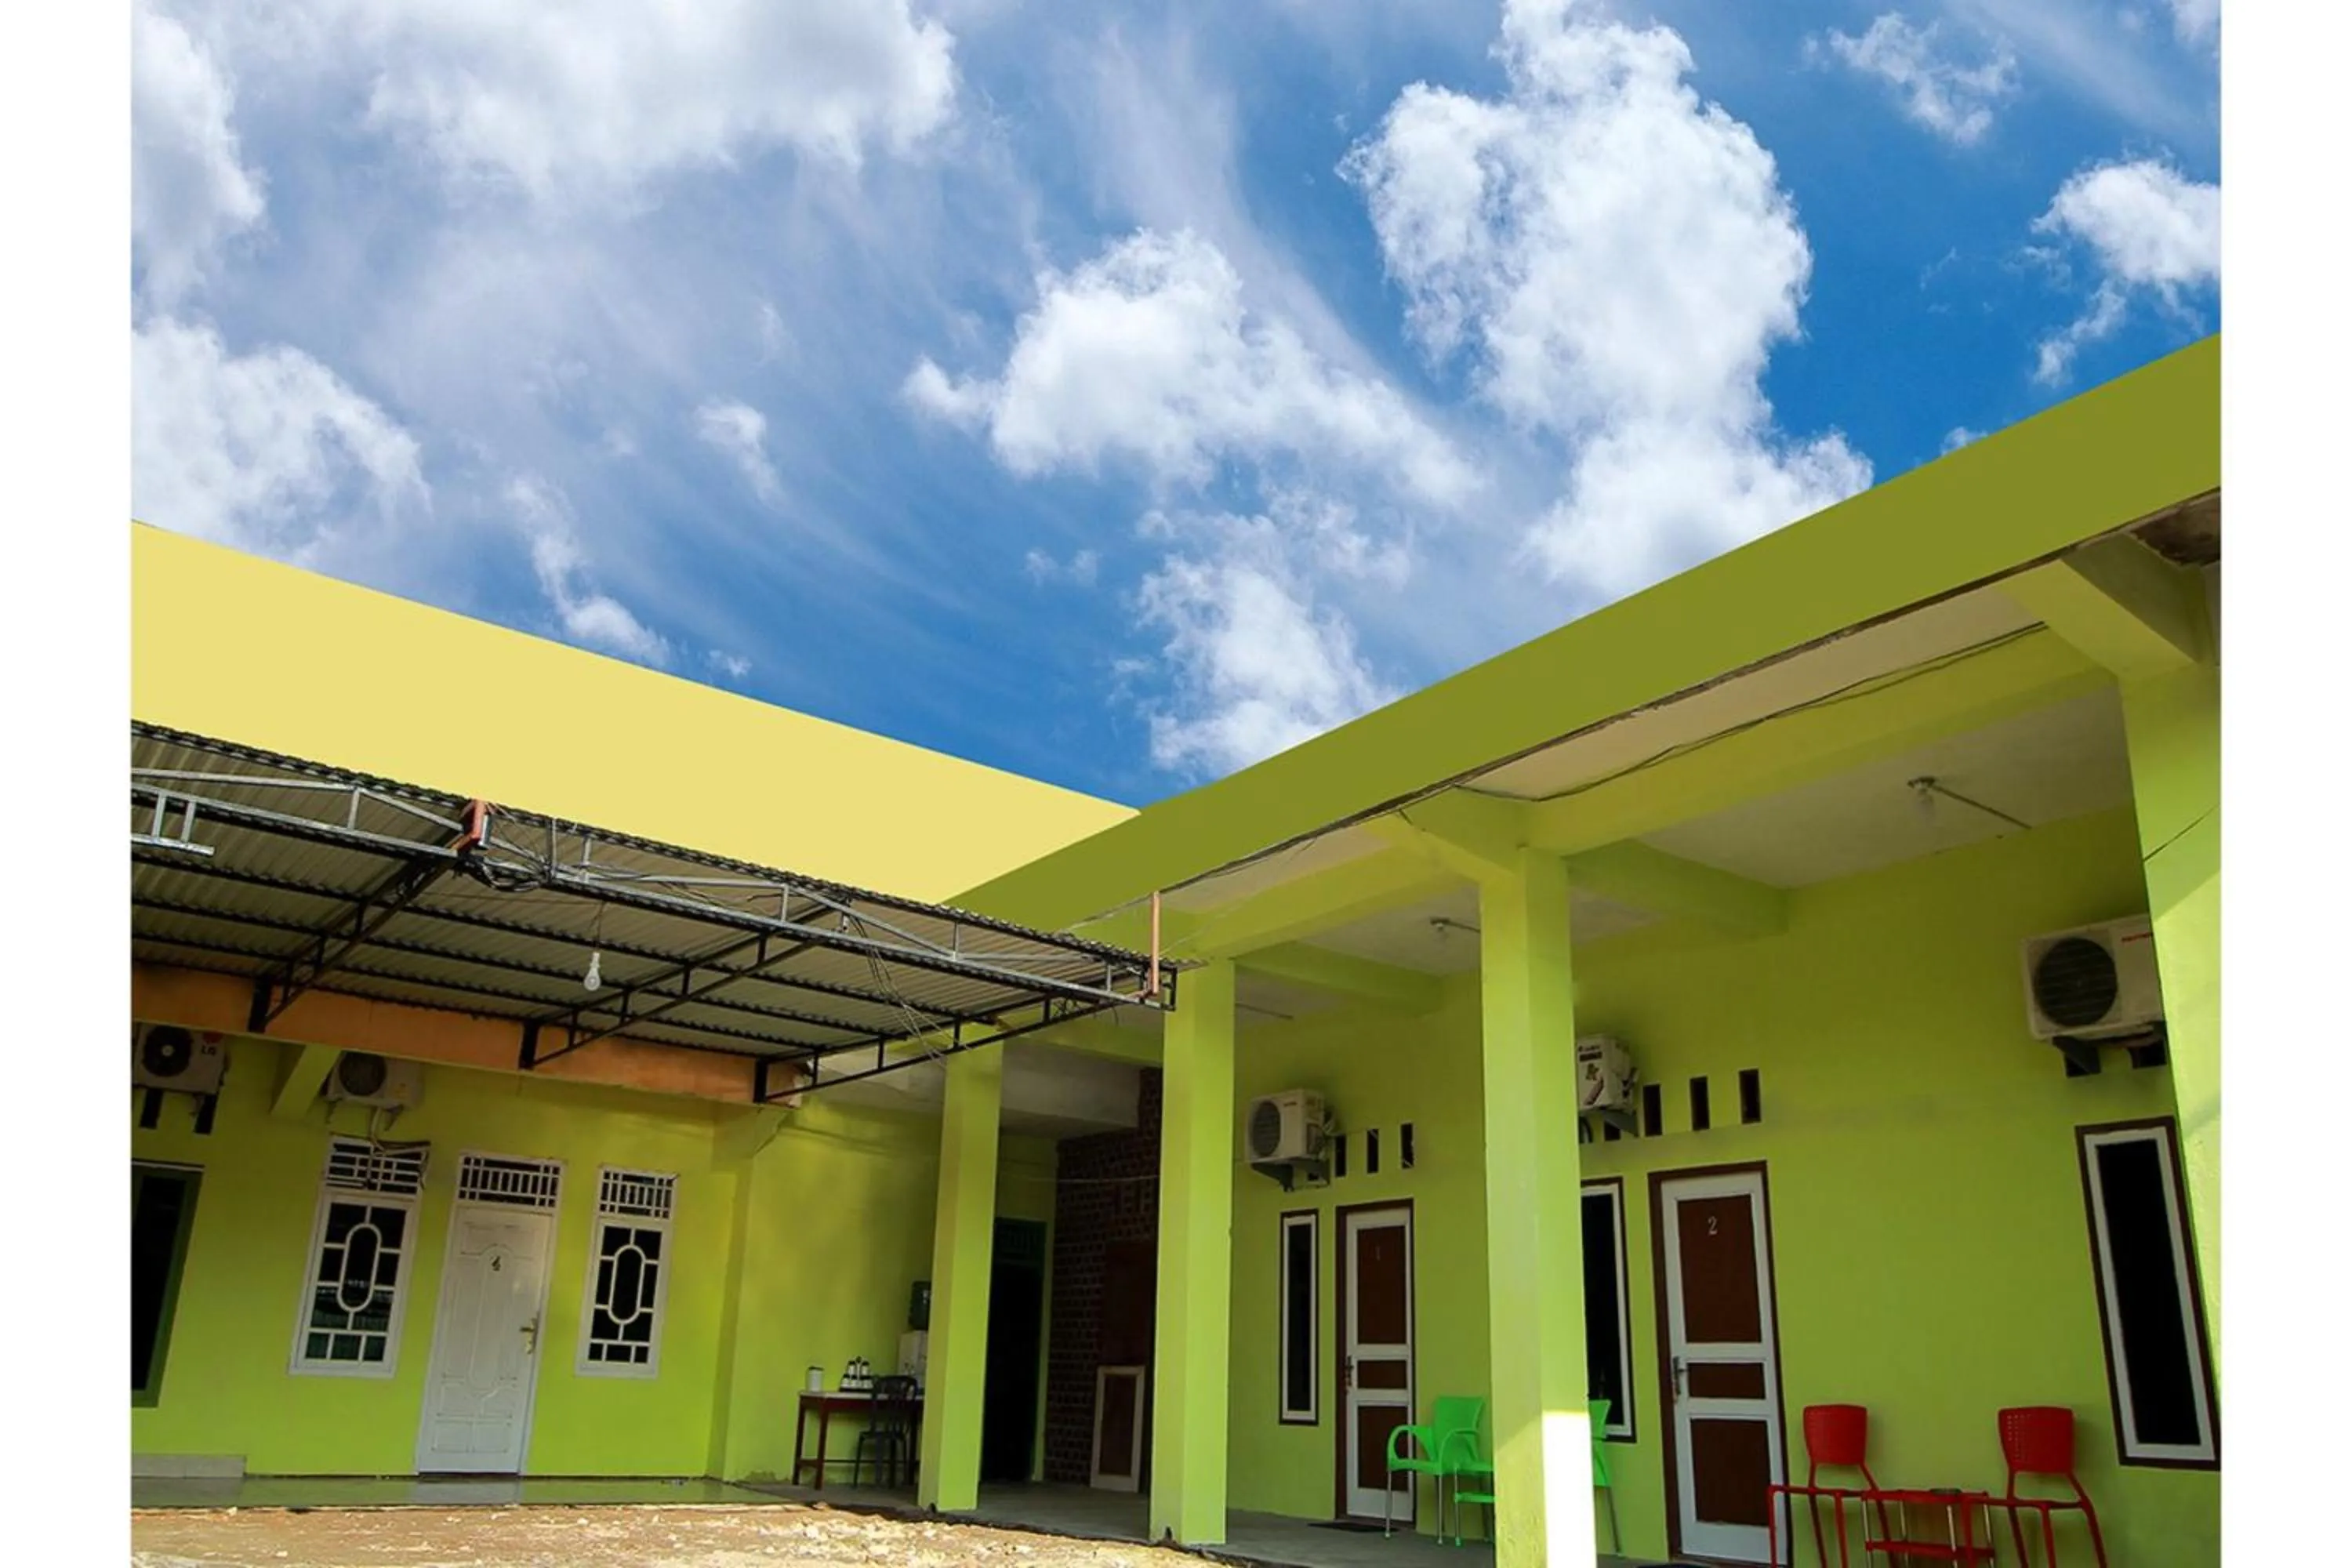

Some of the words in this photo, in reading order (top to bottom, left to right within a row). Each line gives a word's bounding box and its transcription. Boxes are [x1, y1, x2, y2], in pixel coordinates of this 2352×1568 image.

[201, 1044, 217, 1057] LG
[1708, 1215, 1718, 1235] 2
[1374, 1246, 1381, 1261] 1
